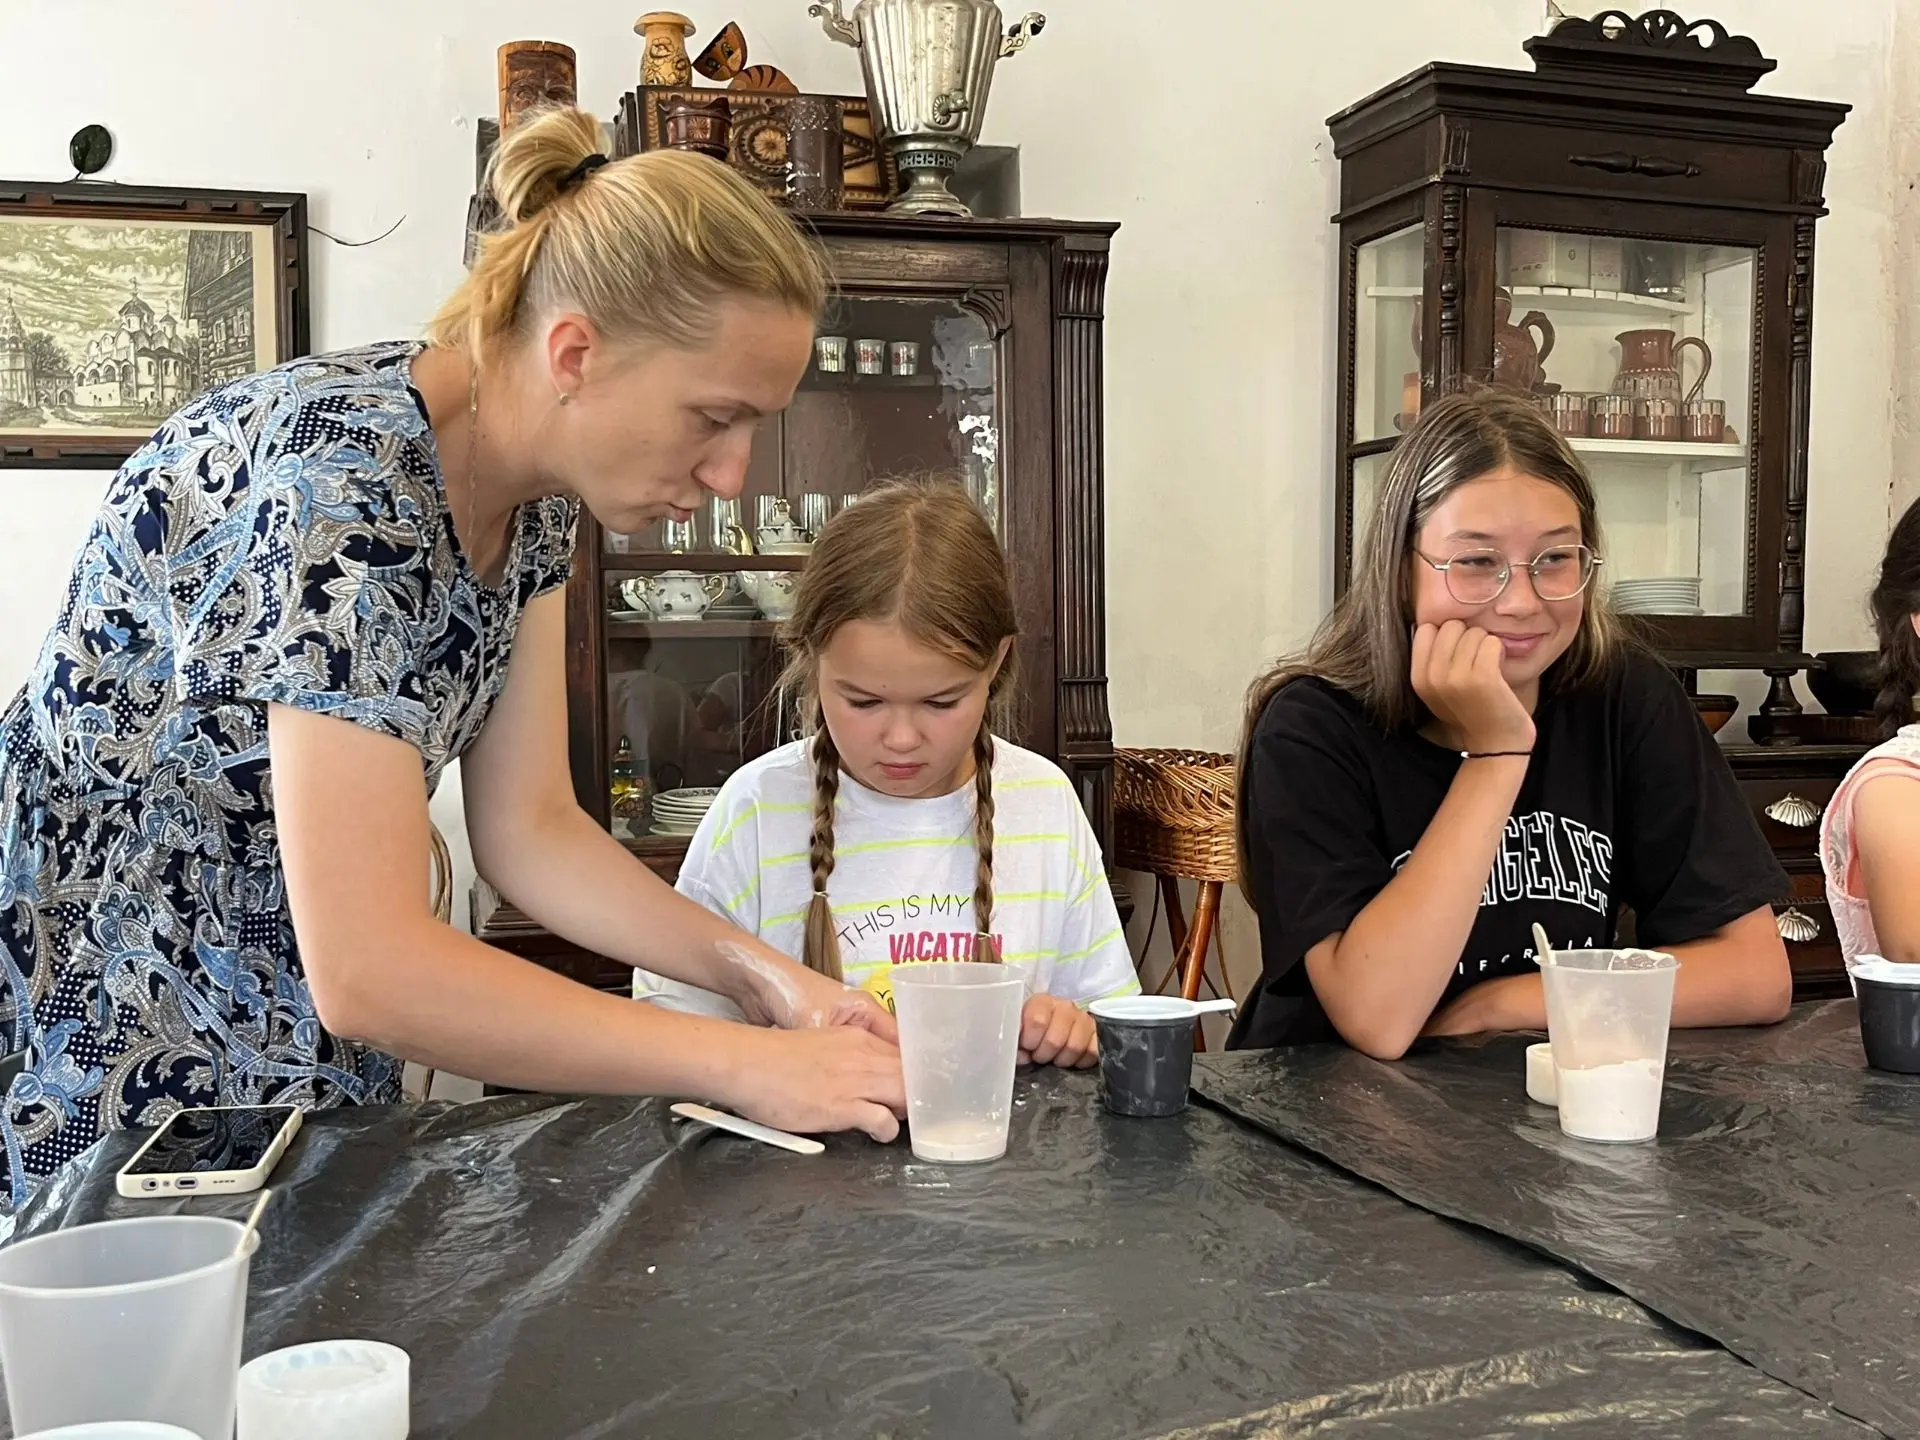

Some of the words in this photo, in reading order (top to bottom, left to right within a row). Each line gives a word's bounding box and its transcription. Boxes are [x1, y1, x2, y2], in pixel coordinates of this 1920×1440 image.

[836, 904, 895, 948] THIS
[901, 894, 921, 920] IS
[929, 893, 970, 917] MY
